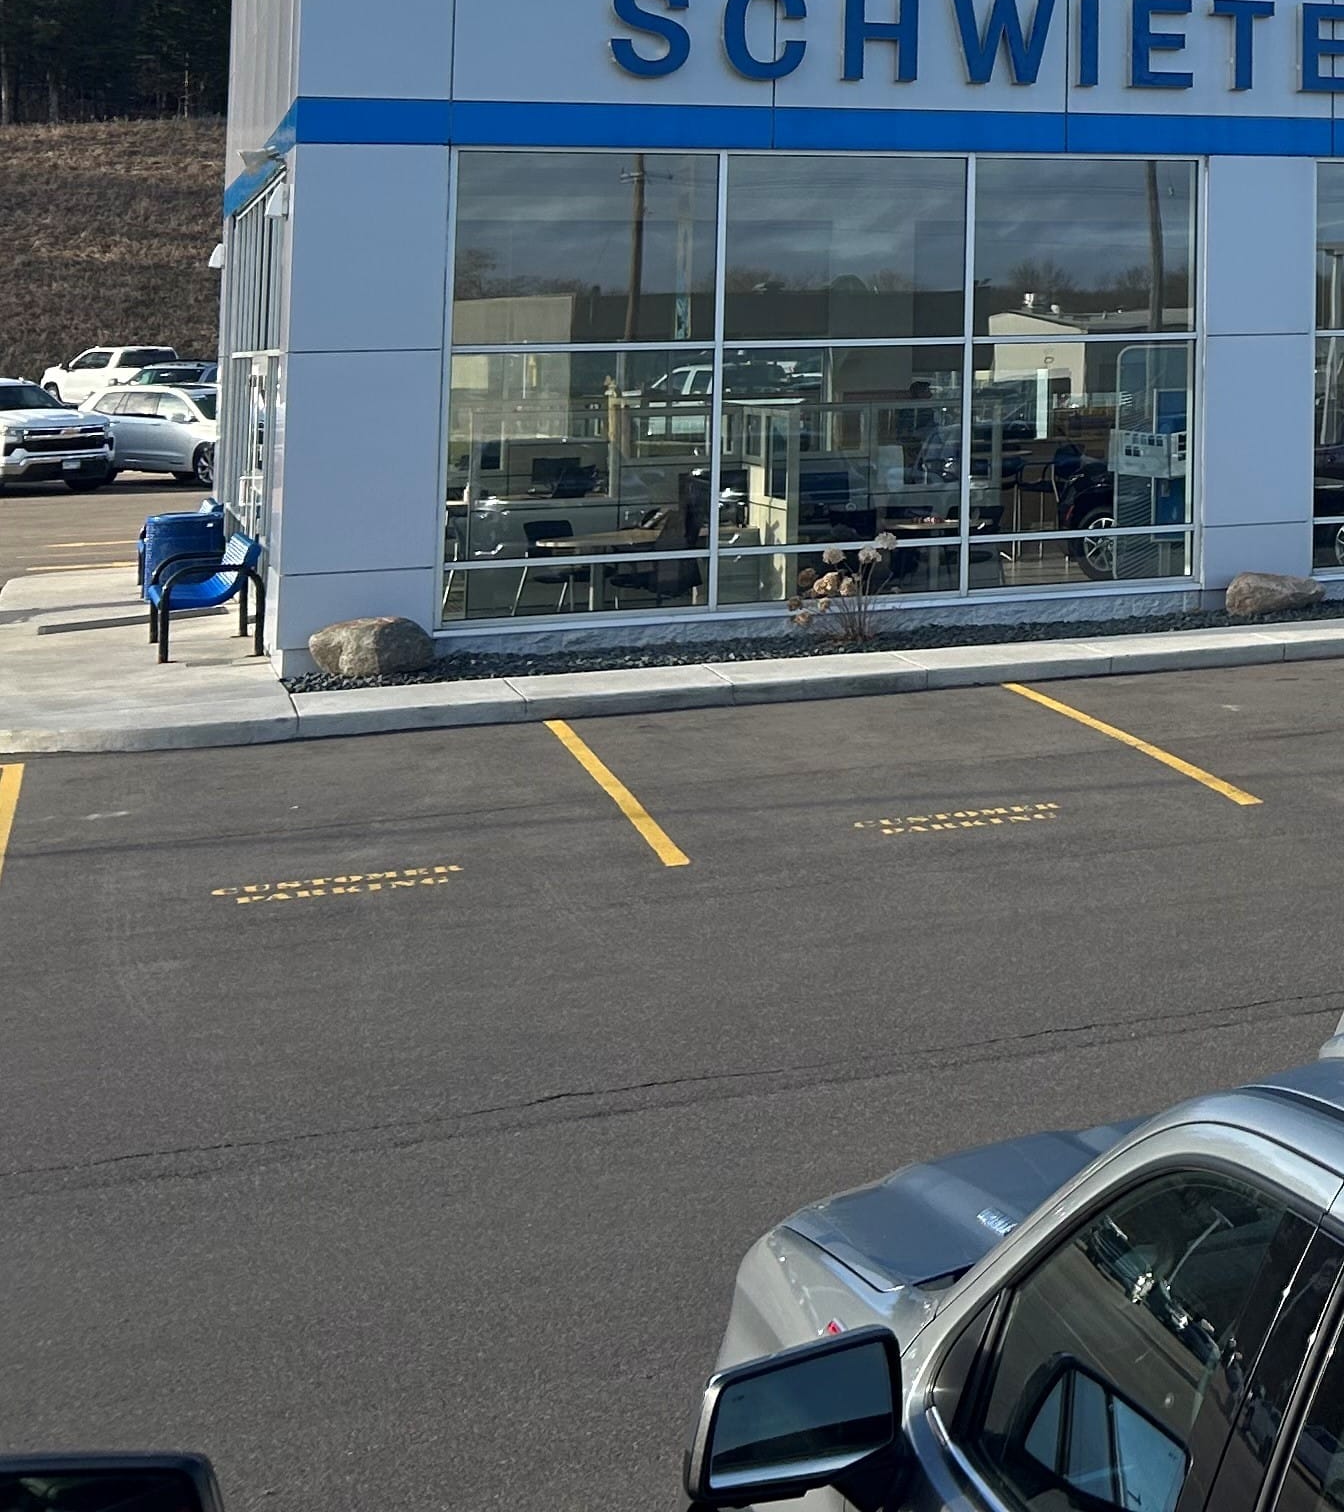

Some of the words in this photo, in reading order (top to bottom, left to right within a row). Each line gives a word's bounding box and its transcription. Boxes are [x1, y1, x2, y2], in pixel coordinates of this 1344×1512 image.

[854, 803, 1061, 828] CUSTOMER
[881, 813, 1056, 834] PARKING
[211, 865, 462, 895] CUSTOMER
[237, 876, 448, 904] PARKING
